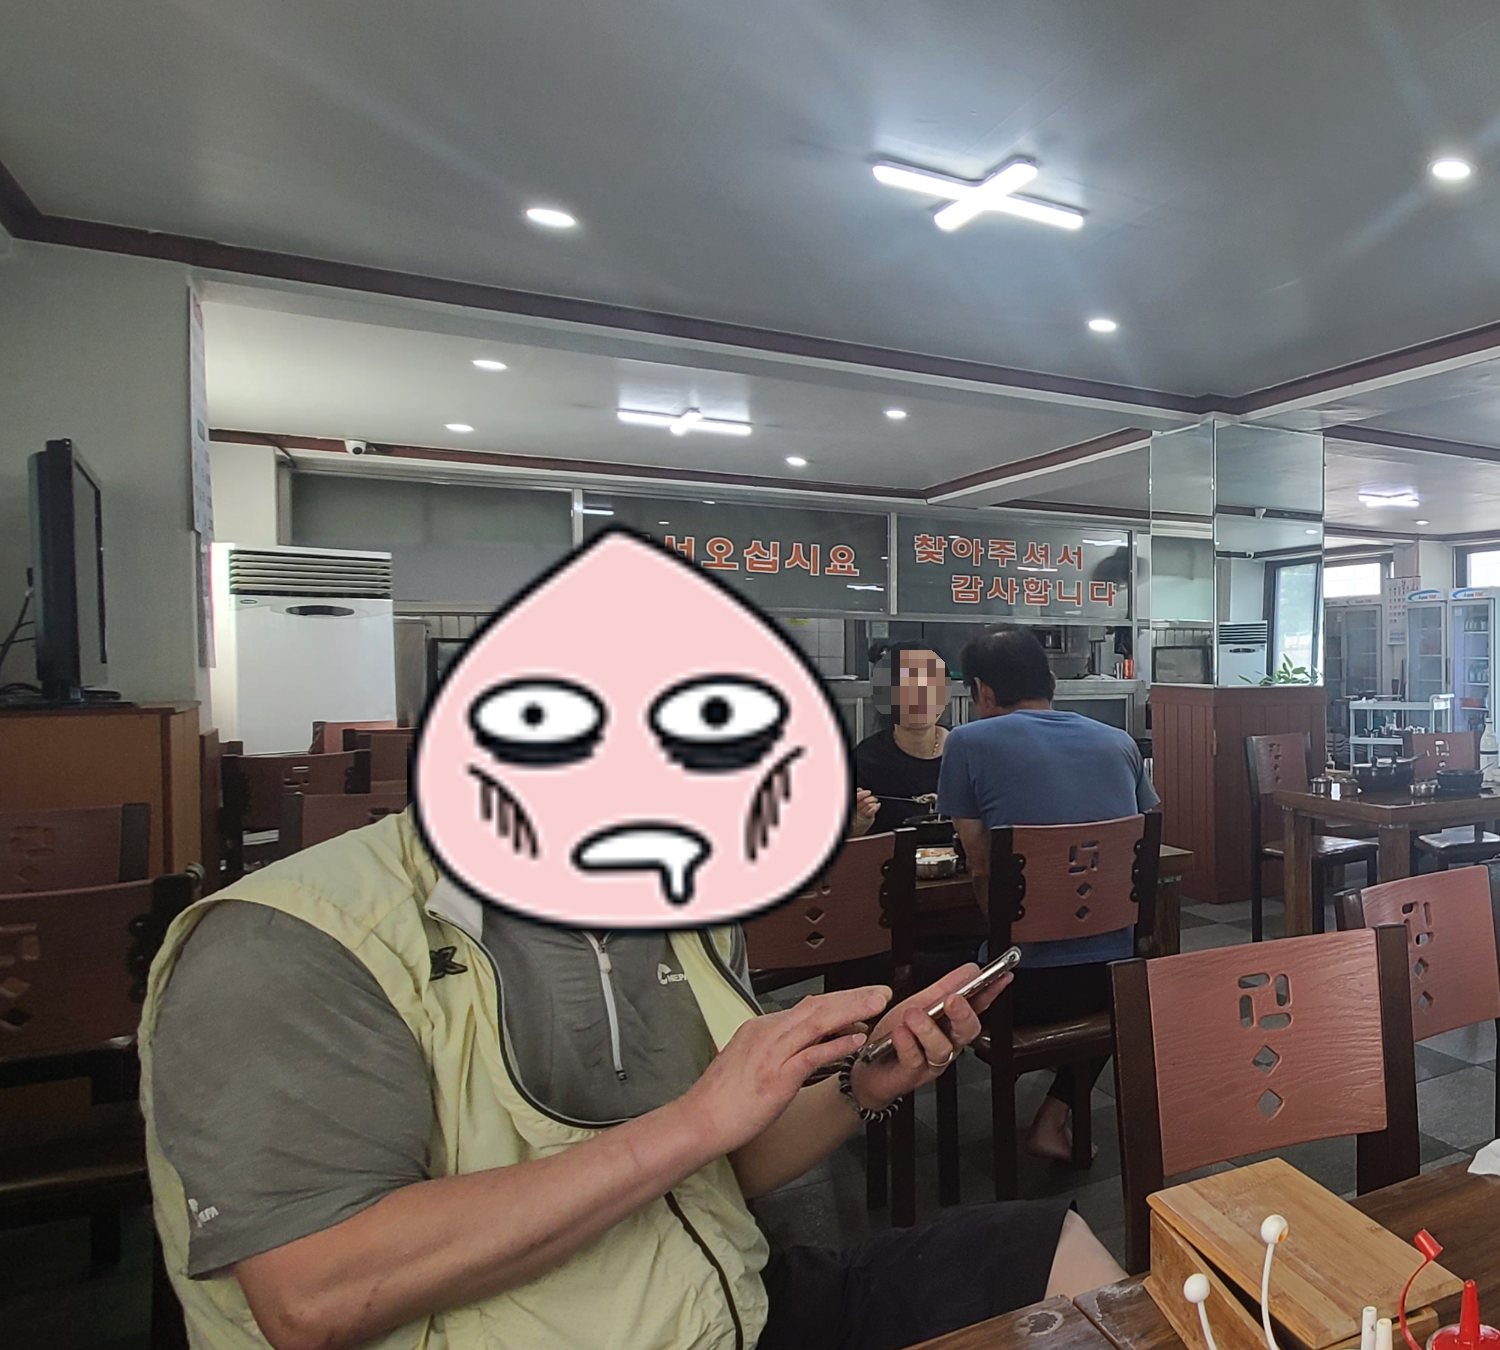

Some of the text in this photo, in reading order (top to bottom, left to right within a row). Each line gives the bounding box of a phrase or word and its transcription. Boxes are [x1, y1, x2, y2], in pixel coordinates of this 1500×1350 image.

[645, 534, 860, 577] 서오십시요
[913, 533, 1084, 571] 찾아주셔서
[951, 574, 1117, 607] 감사합니다
